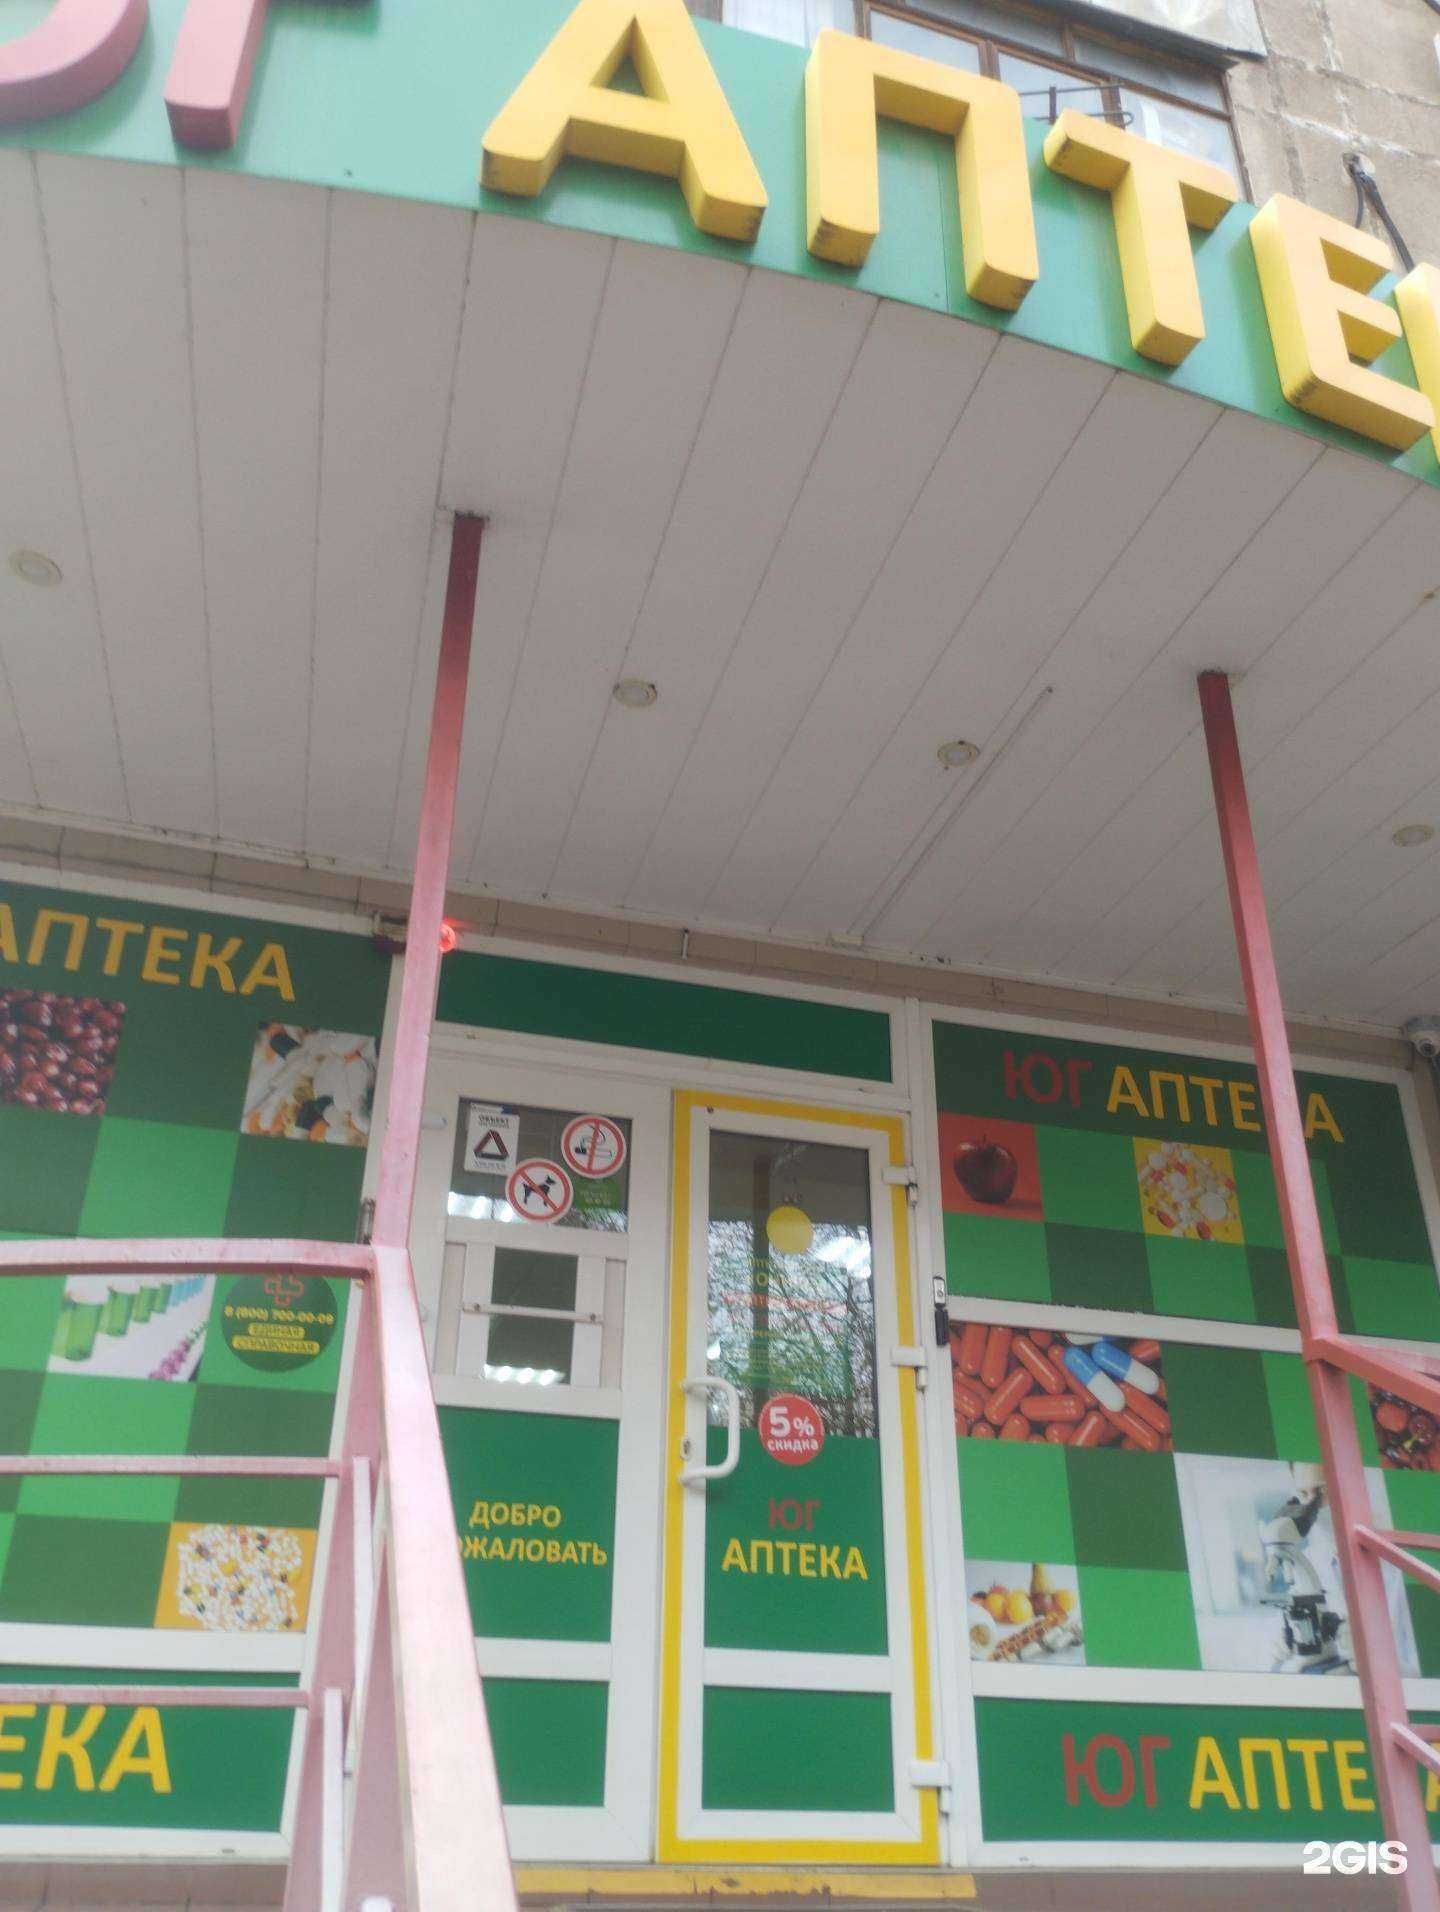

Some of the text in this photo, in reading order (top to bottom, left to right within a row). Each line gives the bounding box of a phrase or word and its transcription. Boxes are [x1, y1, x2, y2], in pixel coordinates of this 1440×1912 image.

[1003, 1050, 1345, 1144] ЮГ АПТЕА
[769, 1405, 816, 1438] 5%
[469, 1501, 562, 1531] ДОБРО
[768, 1498, 821, 1531] ЮГ
[457, 1535, 608, 1566] ЖАЛОВАТЬ
[721, 1538, 869, 1581] АПТЕКА
[1062, 1732, 1440, 1812] ЮГ АПТЕ
